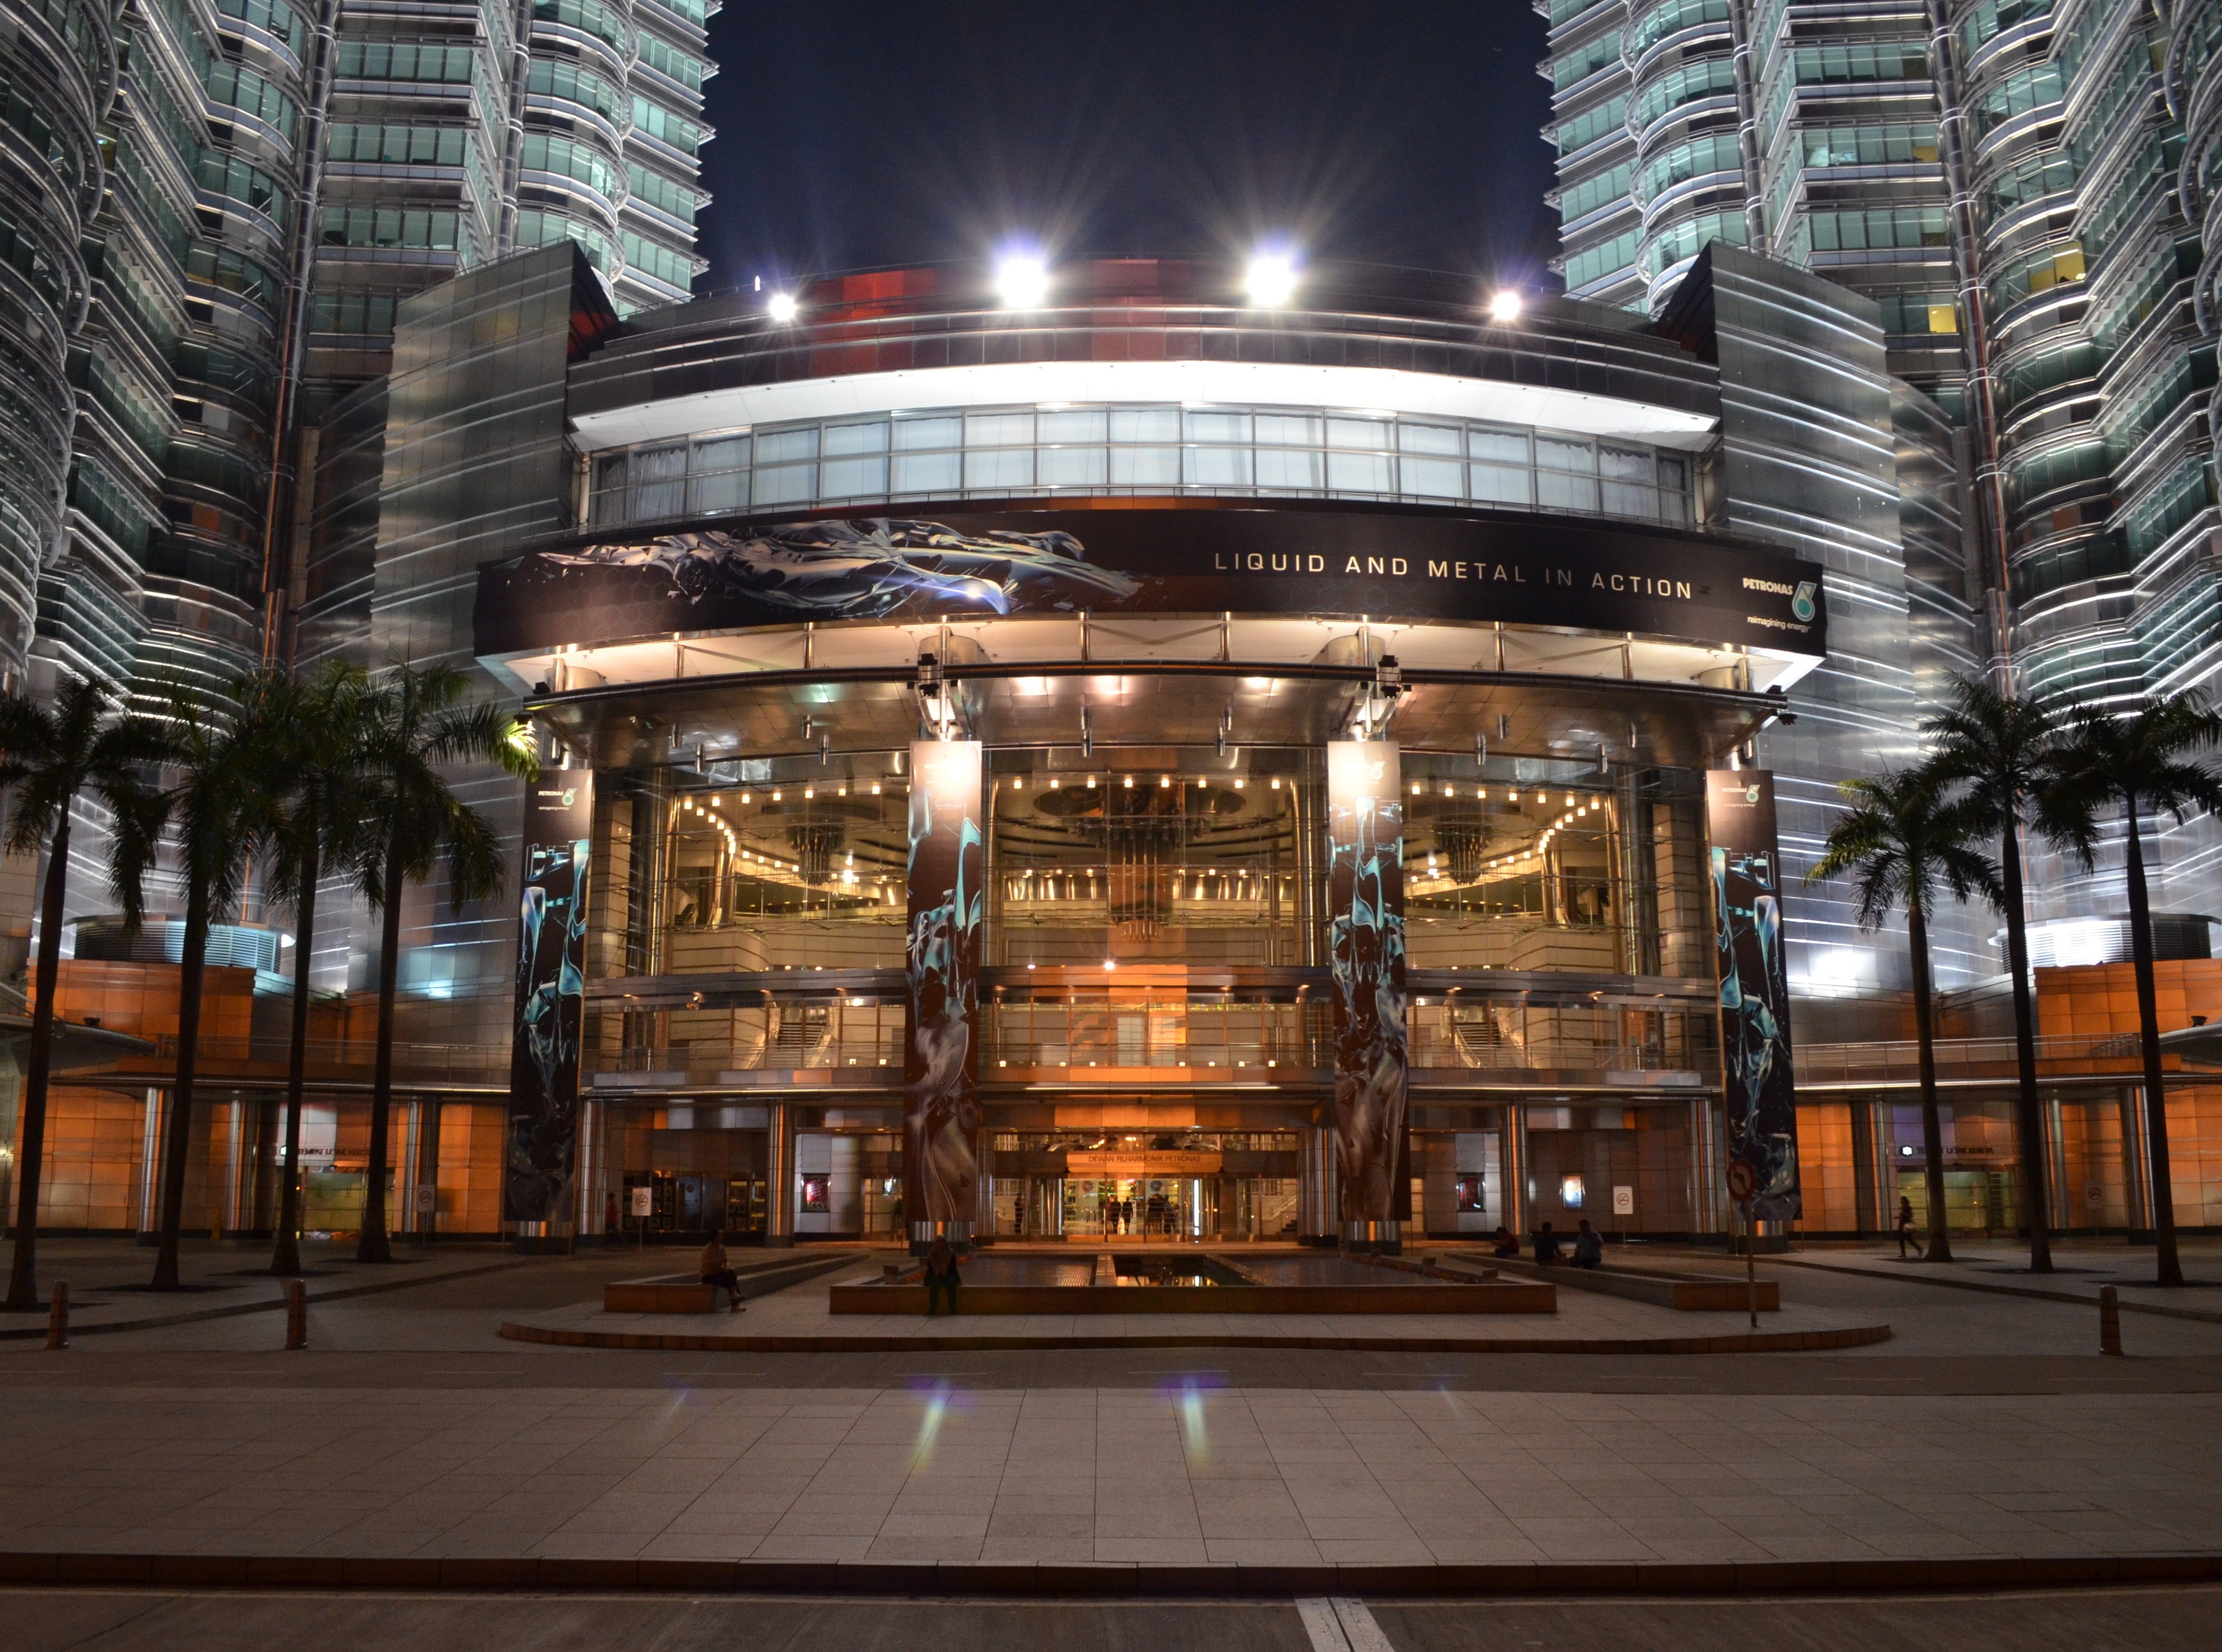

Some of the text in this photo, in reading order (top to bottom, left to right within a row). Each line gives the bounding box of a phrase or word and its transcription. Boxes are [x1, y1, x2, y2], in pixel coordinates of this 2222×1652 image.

[1215, 552, 1691, 599] LIQUID AND METAL IN ACTION
[1742, 577, 1793, 596] PETRONAS
[1747, 616, 1786, 630] reimagining
